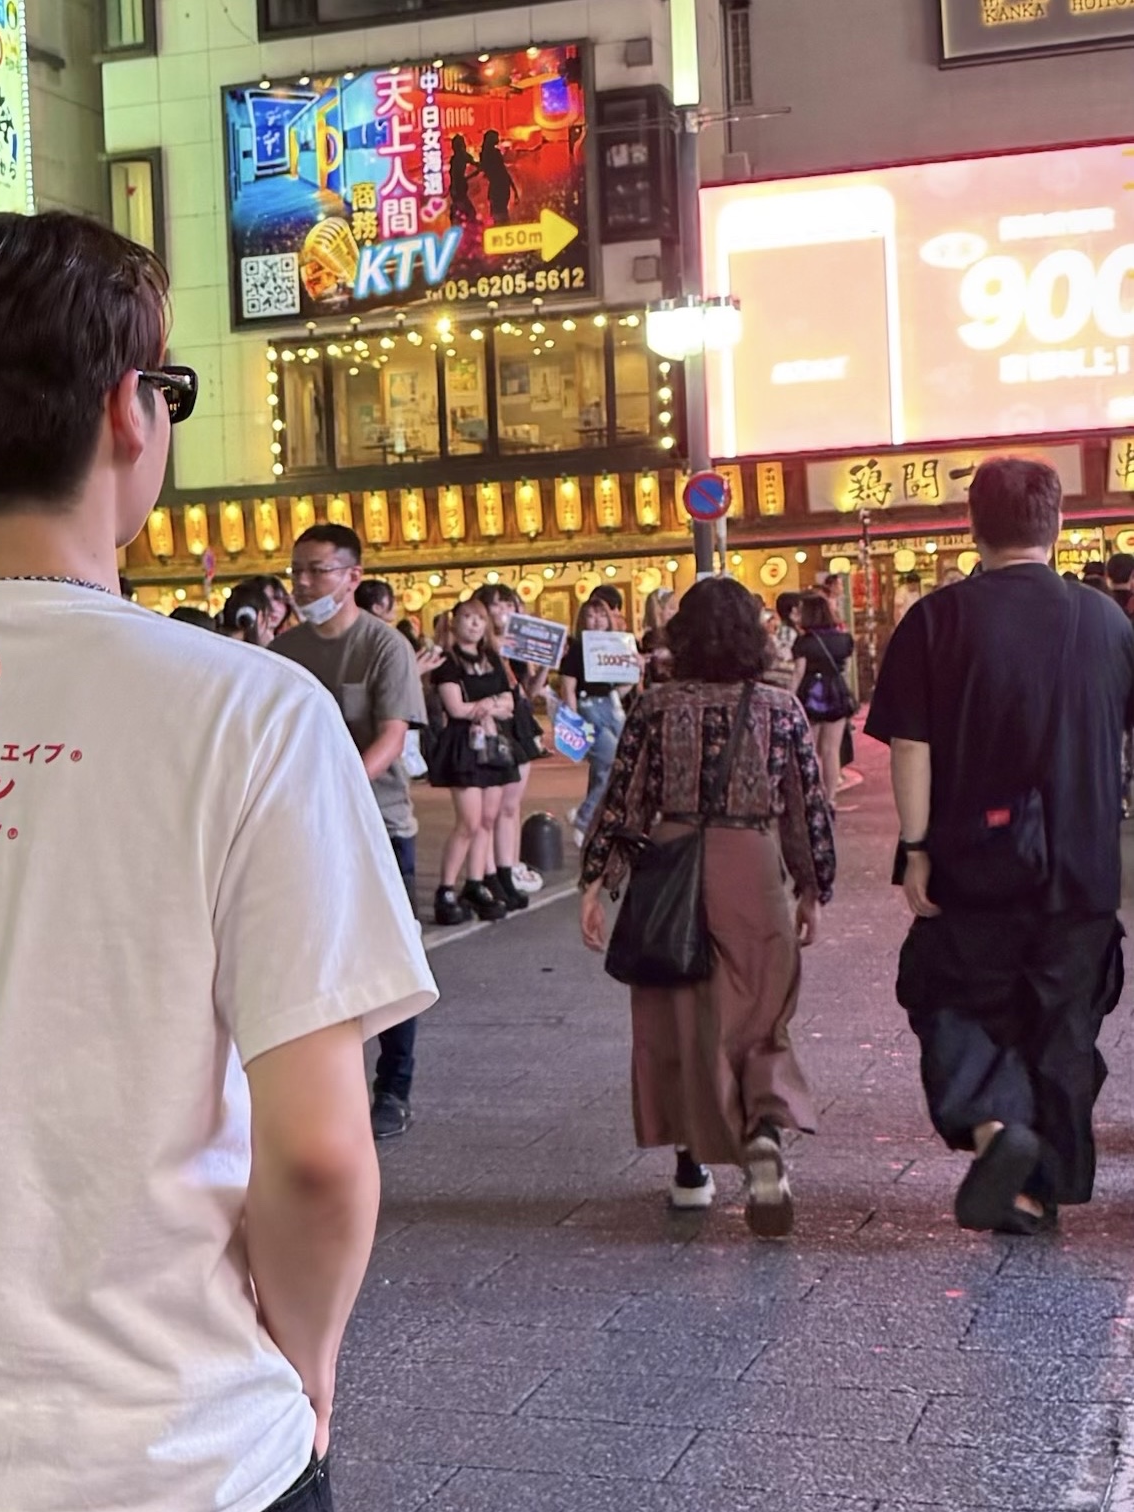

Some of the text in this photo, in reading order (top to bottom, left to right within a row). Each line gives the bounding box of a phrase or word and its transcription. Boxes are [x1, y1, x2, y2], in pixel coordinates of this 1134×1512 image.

[984, 3, 1046, 24] KANKA
[374, 72, 419, 239] 天上人間
[351, 181, 379, 241] 商務
[354, 227, 464, 298] KTV
[445, 266, 586, 300] 03-6205-5612
